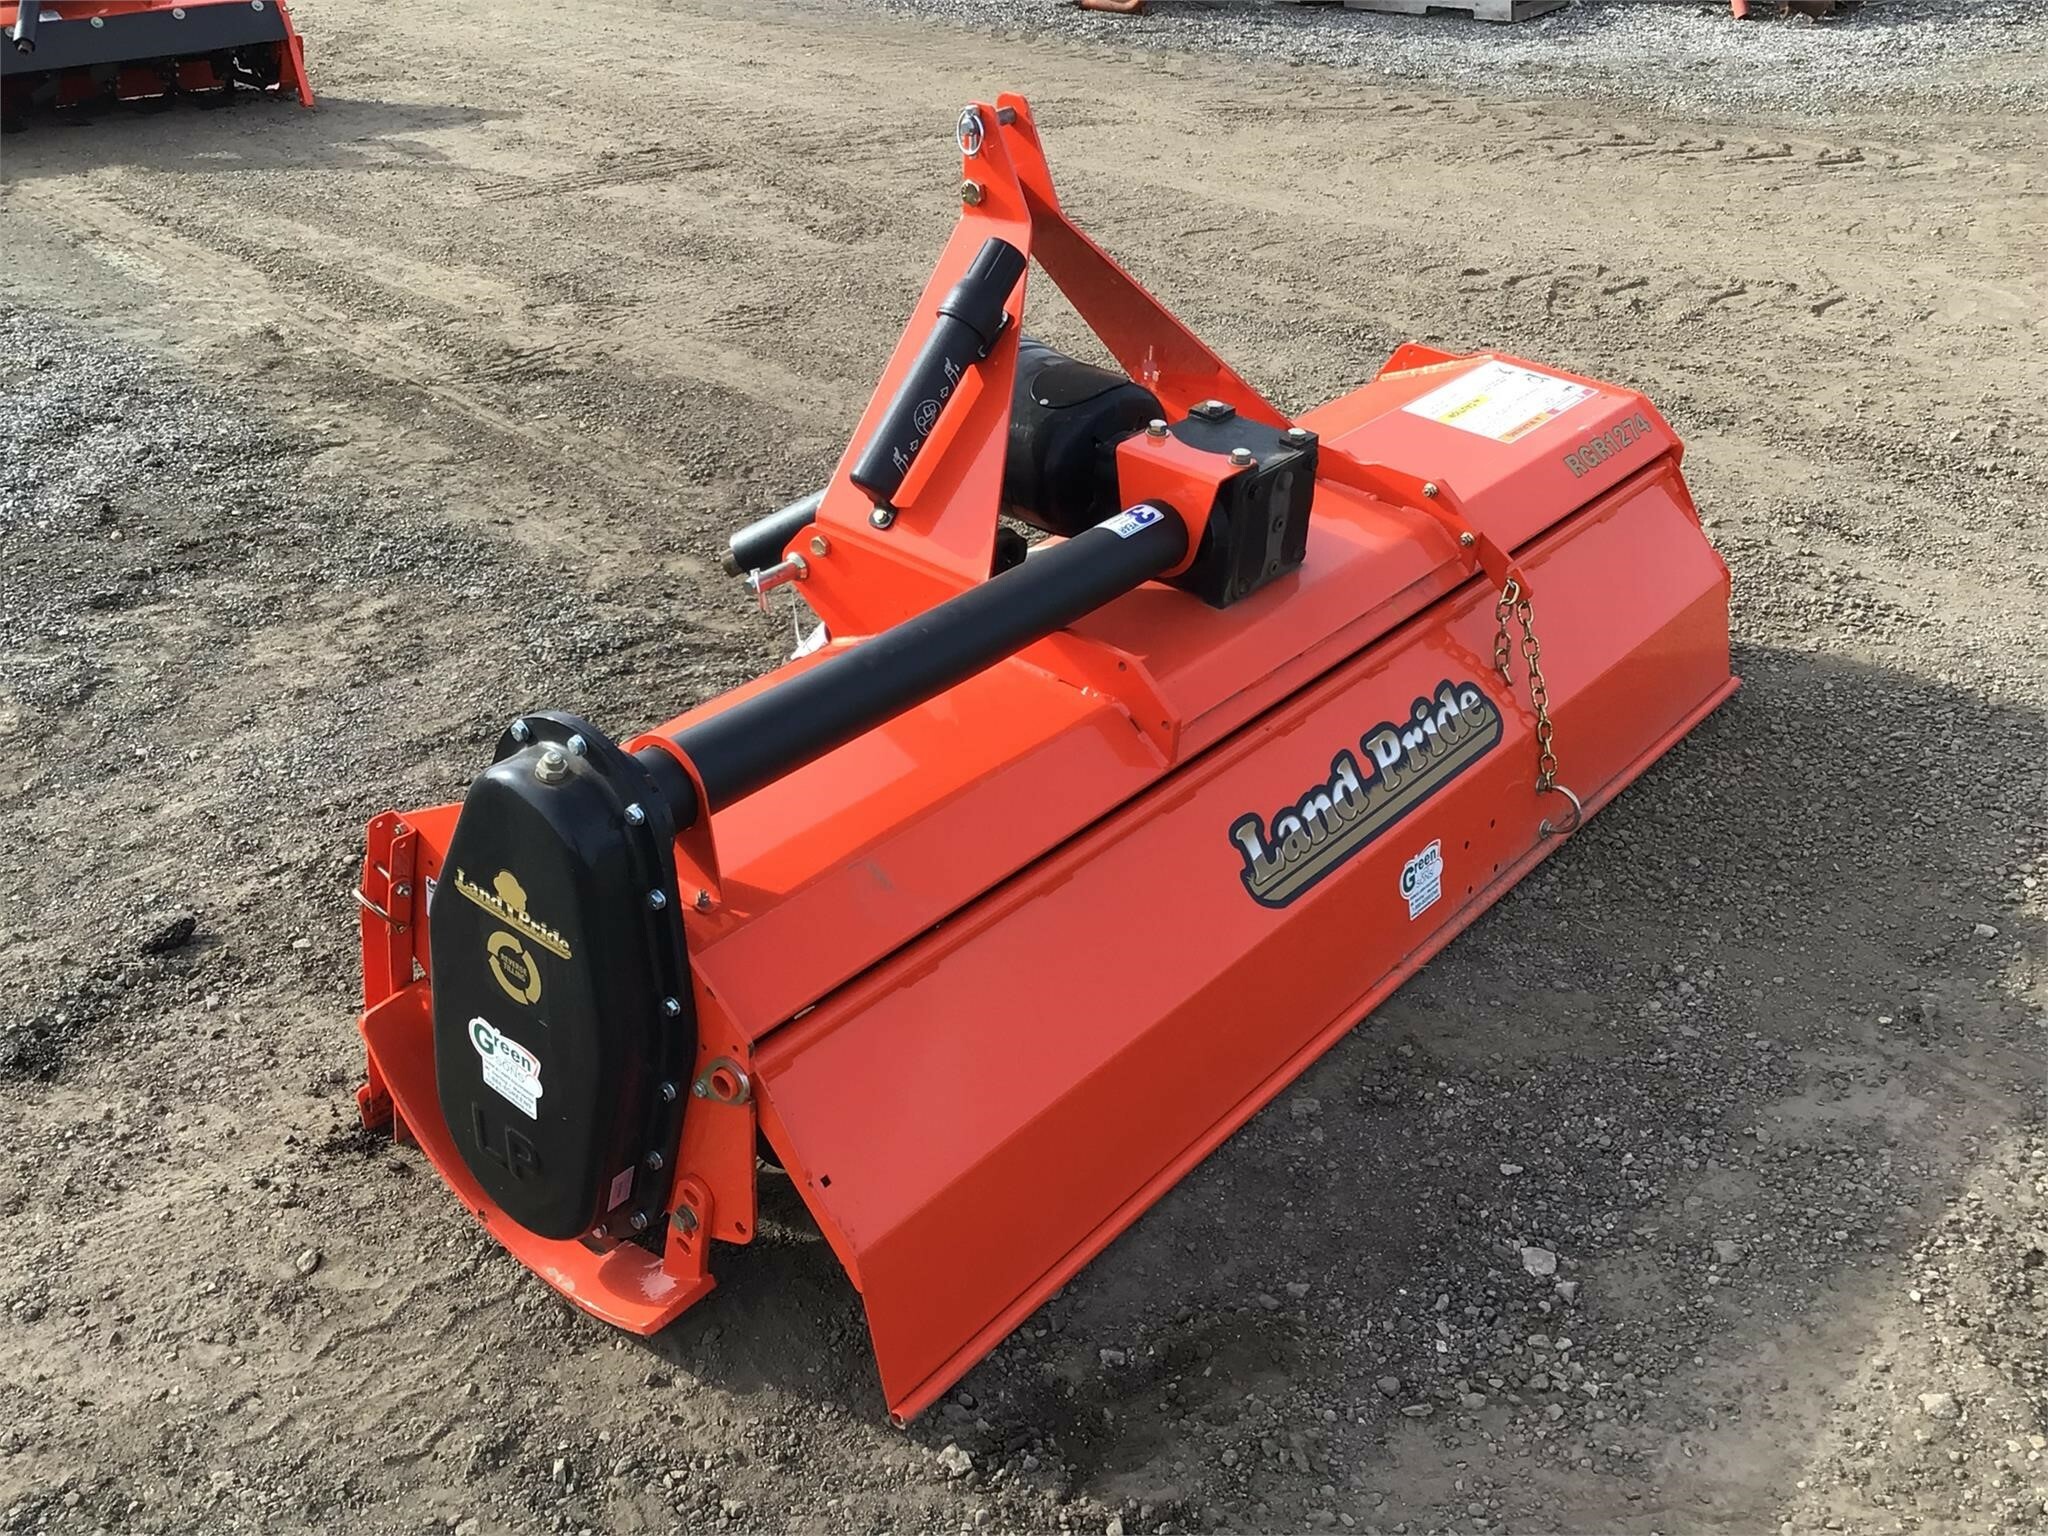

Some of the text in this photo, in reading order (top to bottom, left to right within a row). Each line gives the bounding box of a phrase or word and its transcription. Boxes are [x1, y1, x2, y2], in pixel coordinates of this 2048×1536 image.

[1563, 413, 1652, 478] RGR1274
[1236, 686, 1488, 886] Land Pride
[1402, 849, 1437, 893] Green
[456, 867, 572, 956] Land Pride
[473, 1023, 532, 1072] Green
